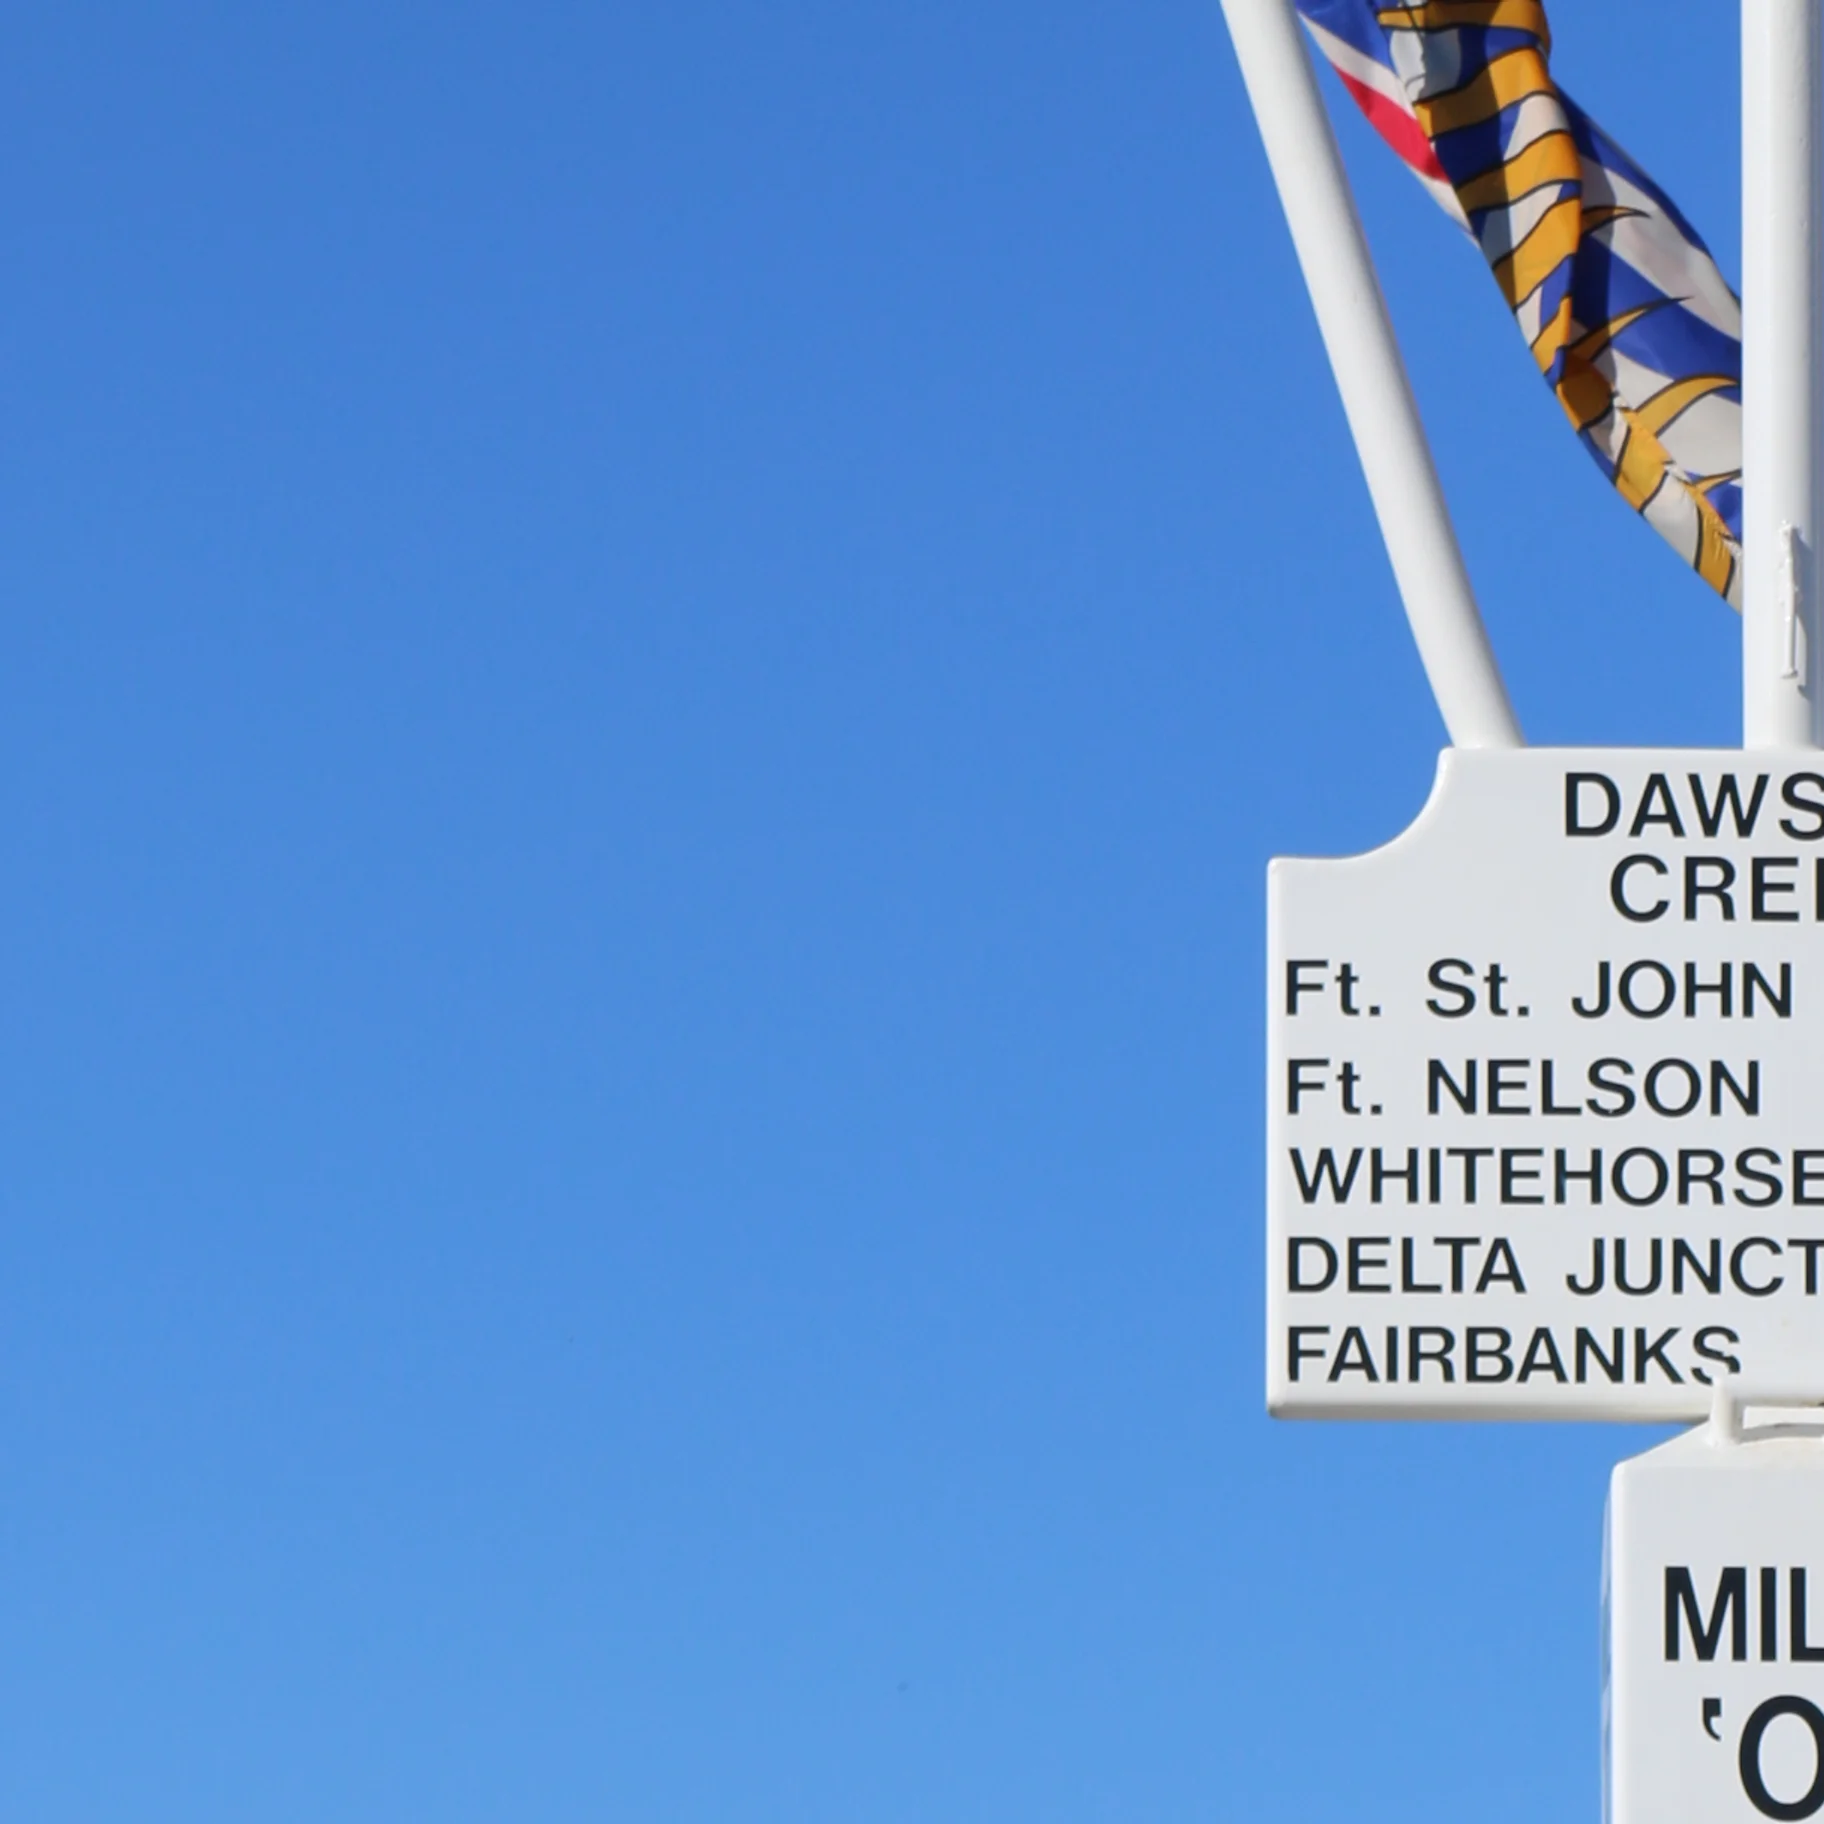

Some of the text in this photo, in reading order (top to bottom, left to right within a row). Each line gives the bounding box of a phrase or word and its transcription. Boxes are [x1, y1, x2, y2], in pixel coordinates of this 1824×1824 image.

[1286, 960, 1380, 1016] Ft.
[1426, 958, 1529, 1018] St.
[1572, 959, 1791, 1019] JOHN
[1287, 1058, 1382, 1115] Ft.
[1428, 1057, 1759, 1117] NELSON
[1288, 1237, 1526, 1293] DELTA
[1288, 1326, 1741, 1385] FAIRBANKS
